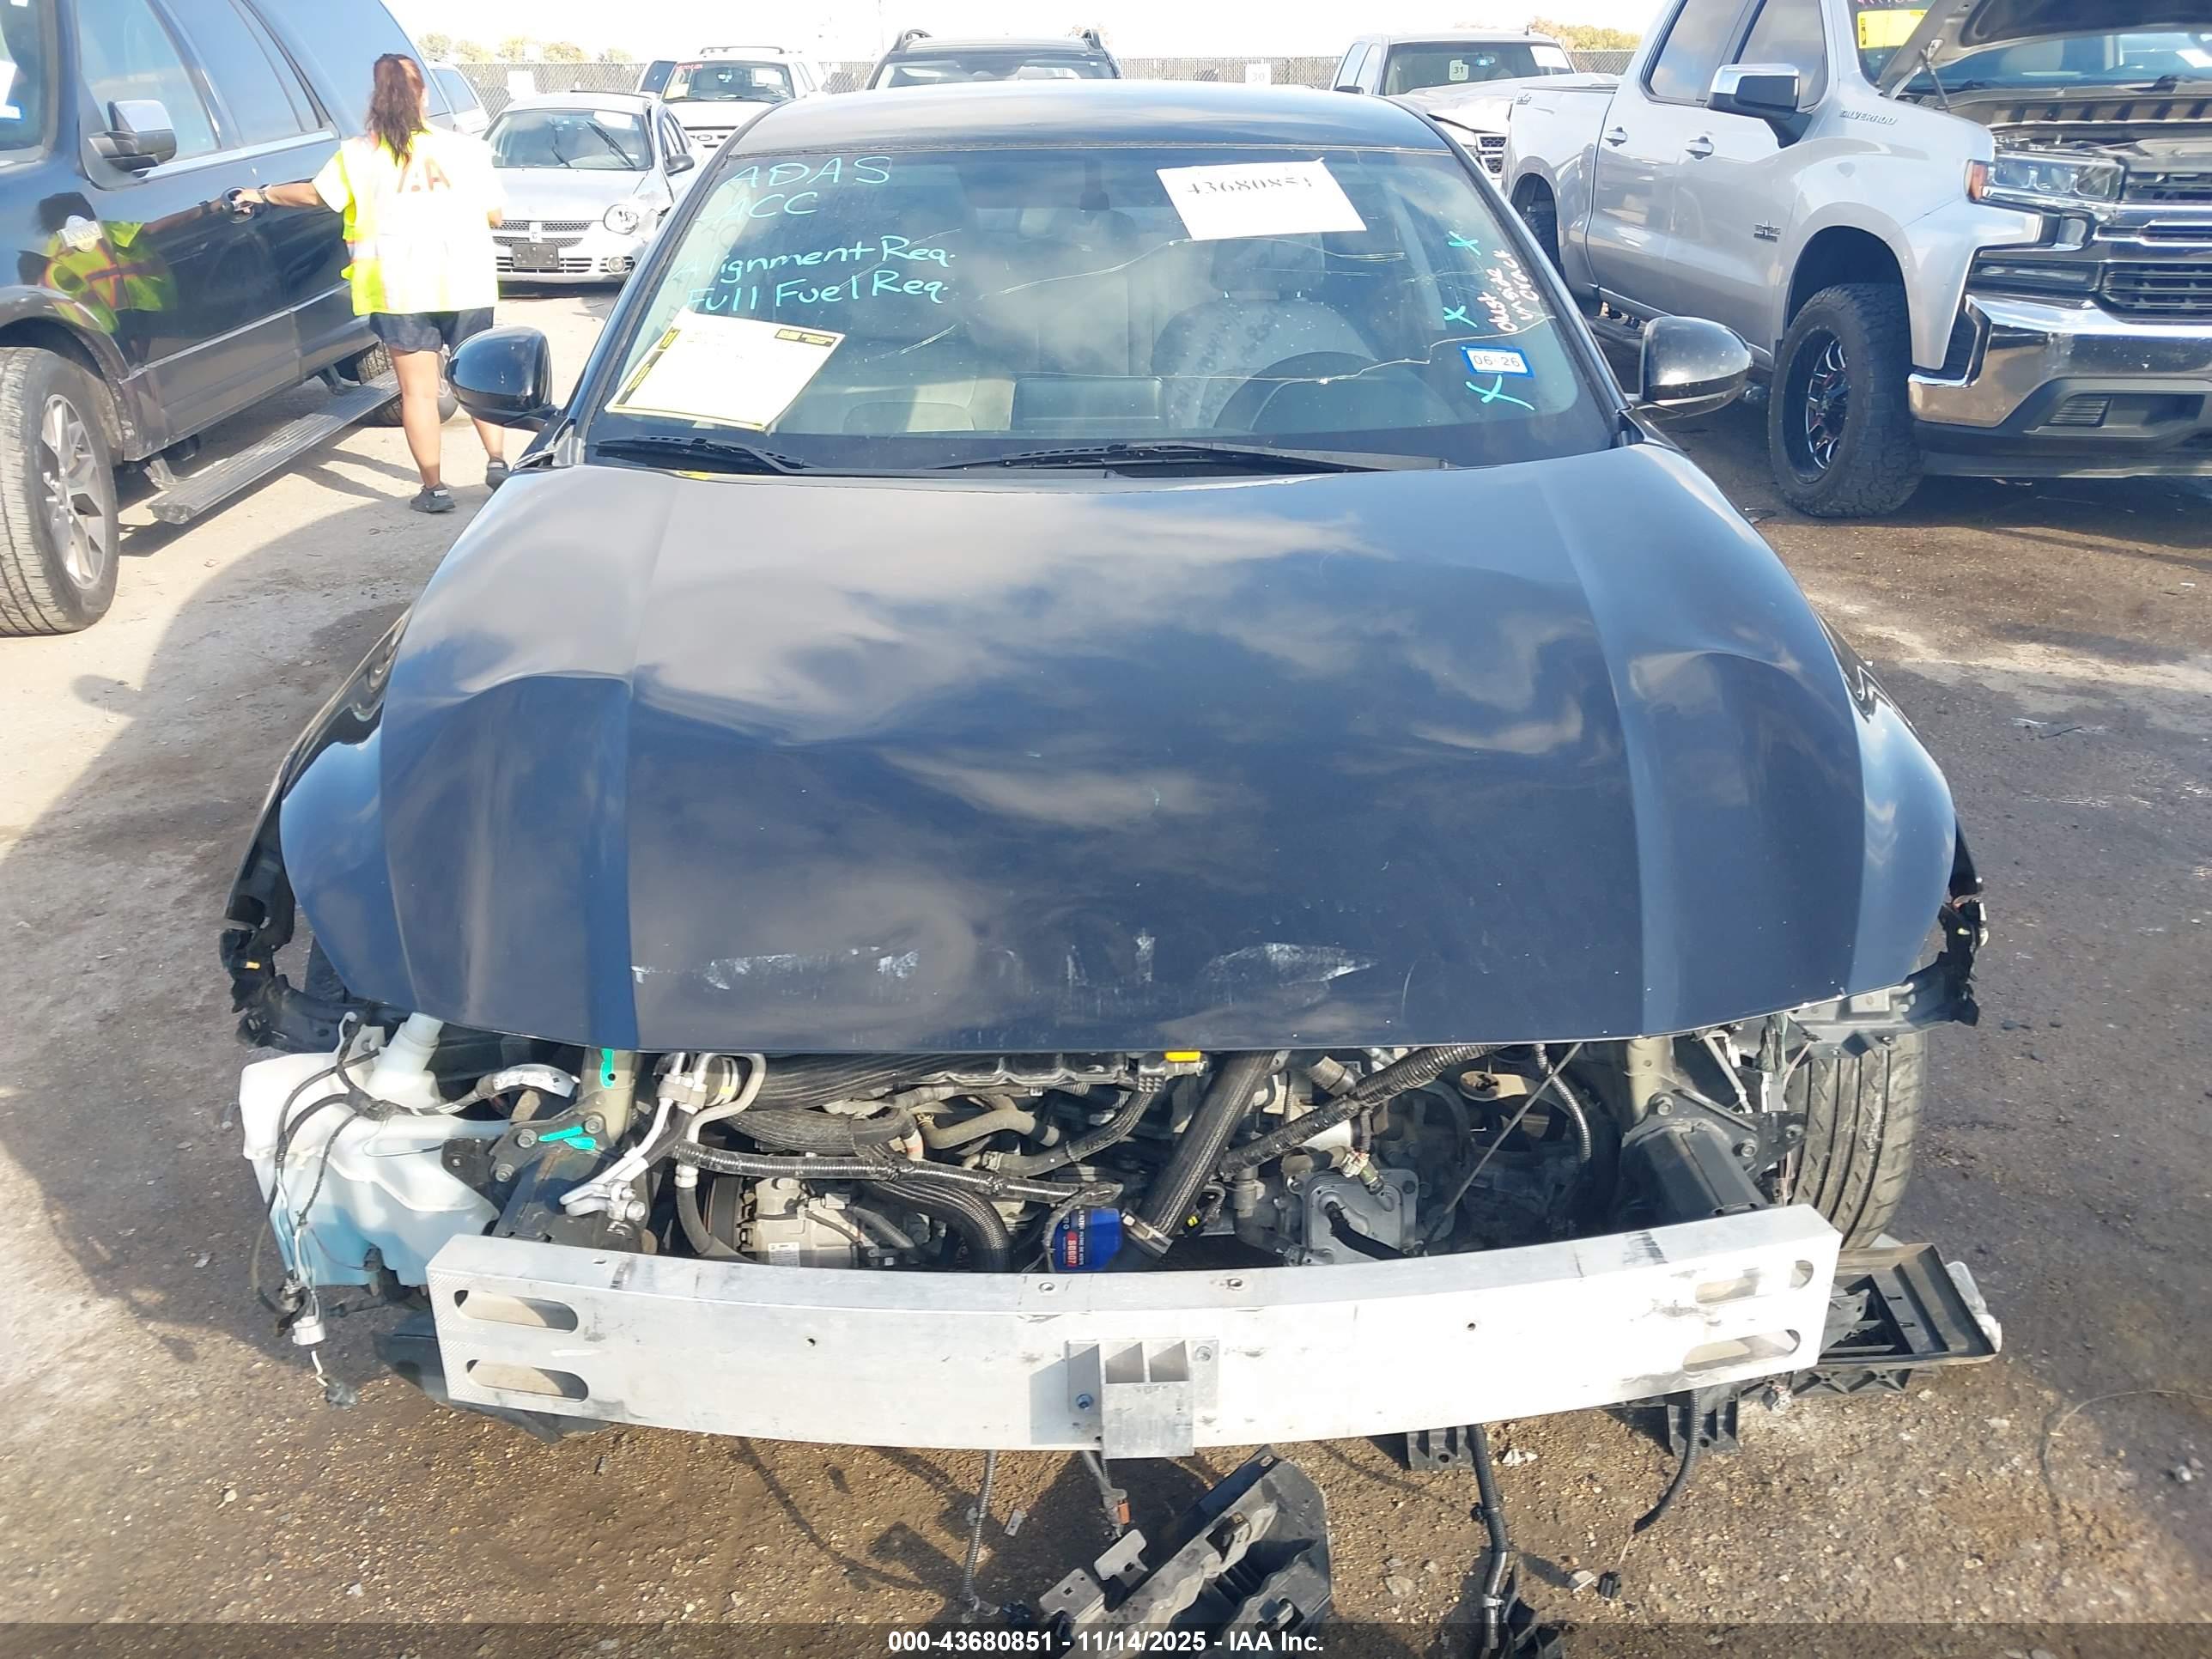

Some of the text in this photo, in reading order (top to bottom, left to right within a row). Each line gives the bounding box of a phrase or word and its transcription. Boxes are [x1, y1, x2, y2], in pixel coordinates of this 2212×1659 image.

[720, 156, 891, 188] ADAS
[668, 234, 957, 284] Alignment Req.
[685, 269, 950, 313] Full Fuel Req.
